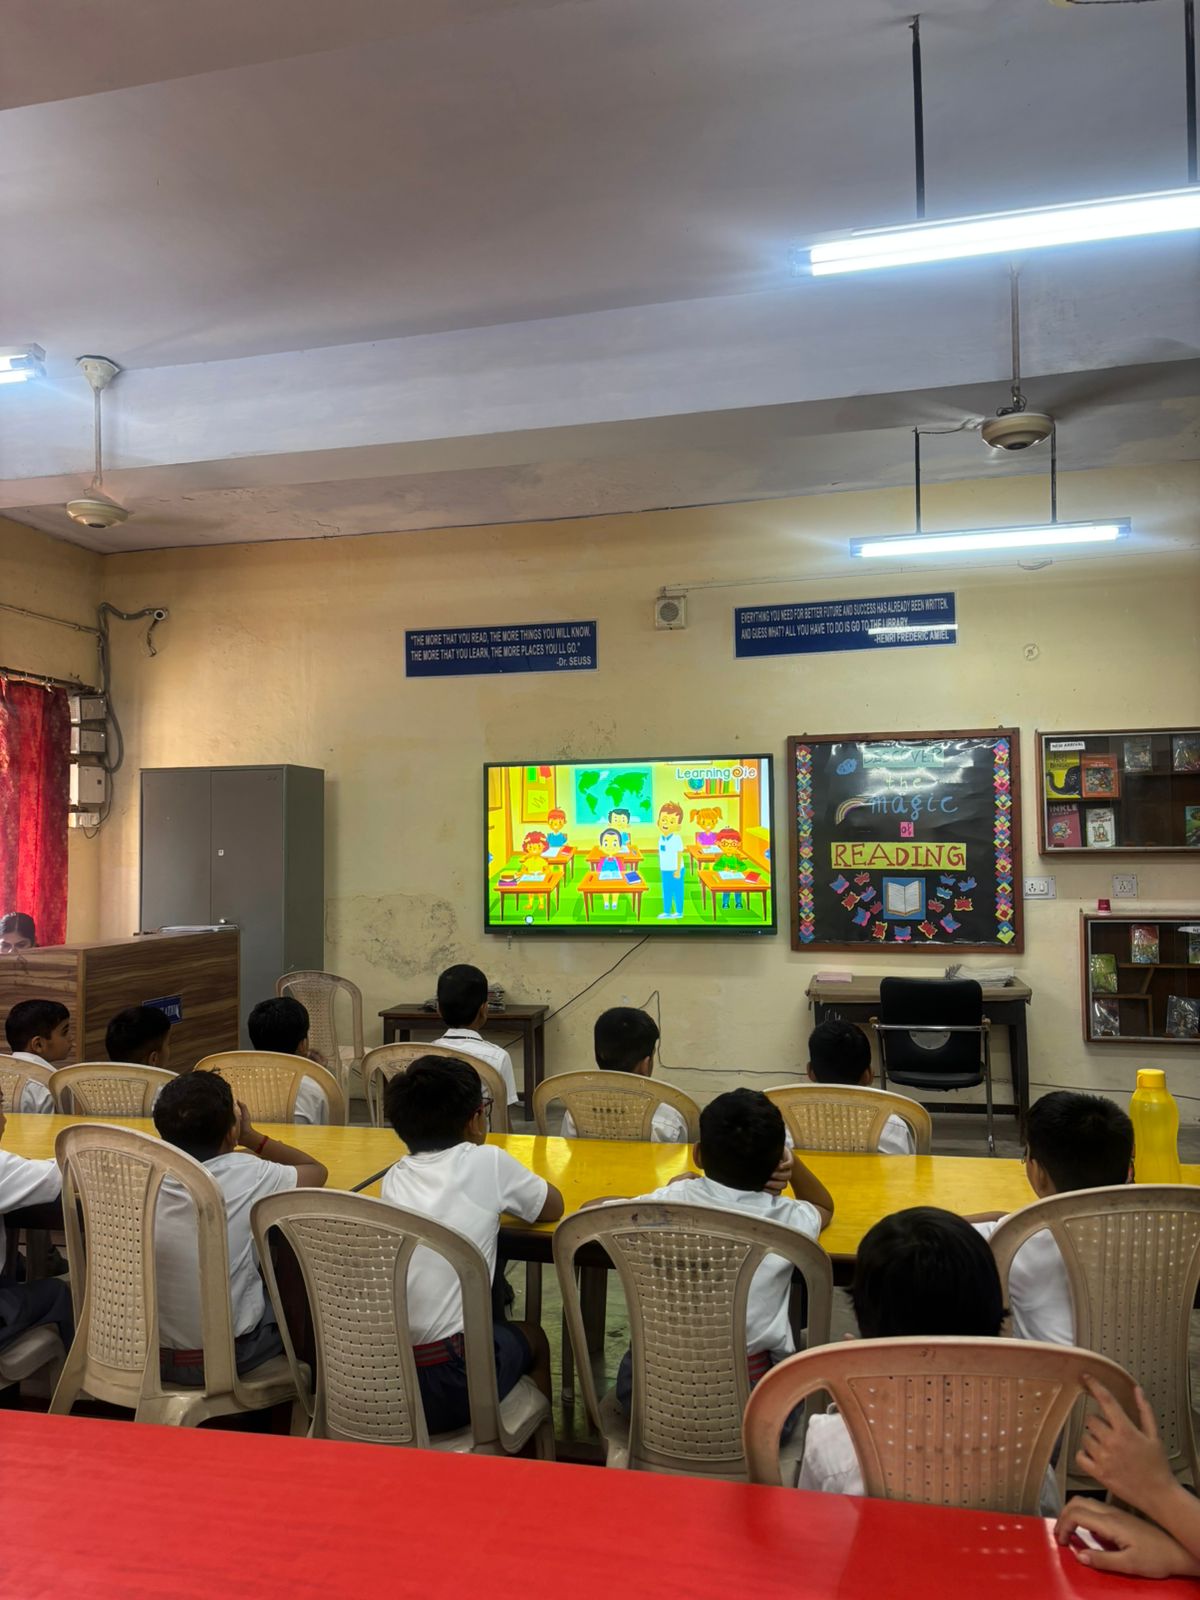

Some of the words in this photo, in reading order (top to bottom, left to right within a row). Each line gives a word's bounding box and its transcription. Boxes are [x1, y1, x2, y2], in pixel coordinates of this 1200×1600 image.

[741, 610, 769, 624] EVERYTHING
[770, 610, 780, 622] YOU
[781, 608, 793, 621] NEED
[794, 607, 804, 620] FOR
[804, 607, 823, 619] BETTER
[823, 605, 842, 618] FUTURE
[843, 604, 853, 616] AND
[854, 602, 876, 616] SUCCESS
[877, 601, 888, 614] HAS
[888, 600, 911, 613] ALREADY
[911, 599, 925, 612] BEEN
[425, 634, 442, 645] MORE
[443, 633, 458, 645] THAT
[458, 633, 471, 644] YOU
[471, 632, 489, 644] READ,
[490, 631, 502, 642] THE
[502, 630, 520, 642] MORE
[520, 629, 542, 641] THINGS
[542, 628, 555, 640] YOU
[556, 627, 571, 639] WILL
[571, 626, 592, 638] KNOW.
[741, 628, 751, 640] AND
[752, 627, 768, 639] GUESS
[768, 626, 785, 638] WHAT?
[785, 624, 796, 637] ALL
[797, 624, 809, 636] YOU
[809, 623, 825, 635] HAVE
[826, 622, 834, 634] TO
[834, 621, 844, 633] DO
[844, 620, 851, 633] IS
[851, 620, 860, 632] GO
[861, 619, 869, 632] TO
[870, 618, 882, 629] THE
[896, 631, 929, 643] FREDERIC
[929, 630, 950, 641] AMIEL
[411, 650, 422, 661] THE
[422, 649, 440, 661] MORE
[440, 648, 455, 660] THAT
[456, 648, 468, 660] YOU
[469, 647, 490, 660] LEARN,
[491, 646, 502, 658] THE
[503, 645, 521, 657] MORE
[521, 644, 545, 656] PLACES
[557, 657, 568, 667] -Dr.
[569, 656, 592, 666] SEUSS
[886, 775, 922, 790] the
[871, 793, 959, 821] magic
[833, 843, 966, 868] READING
